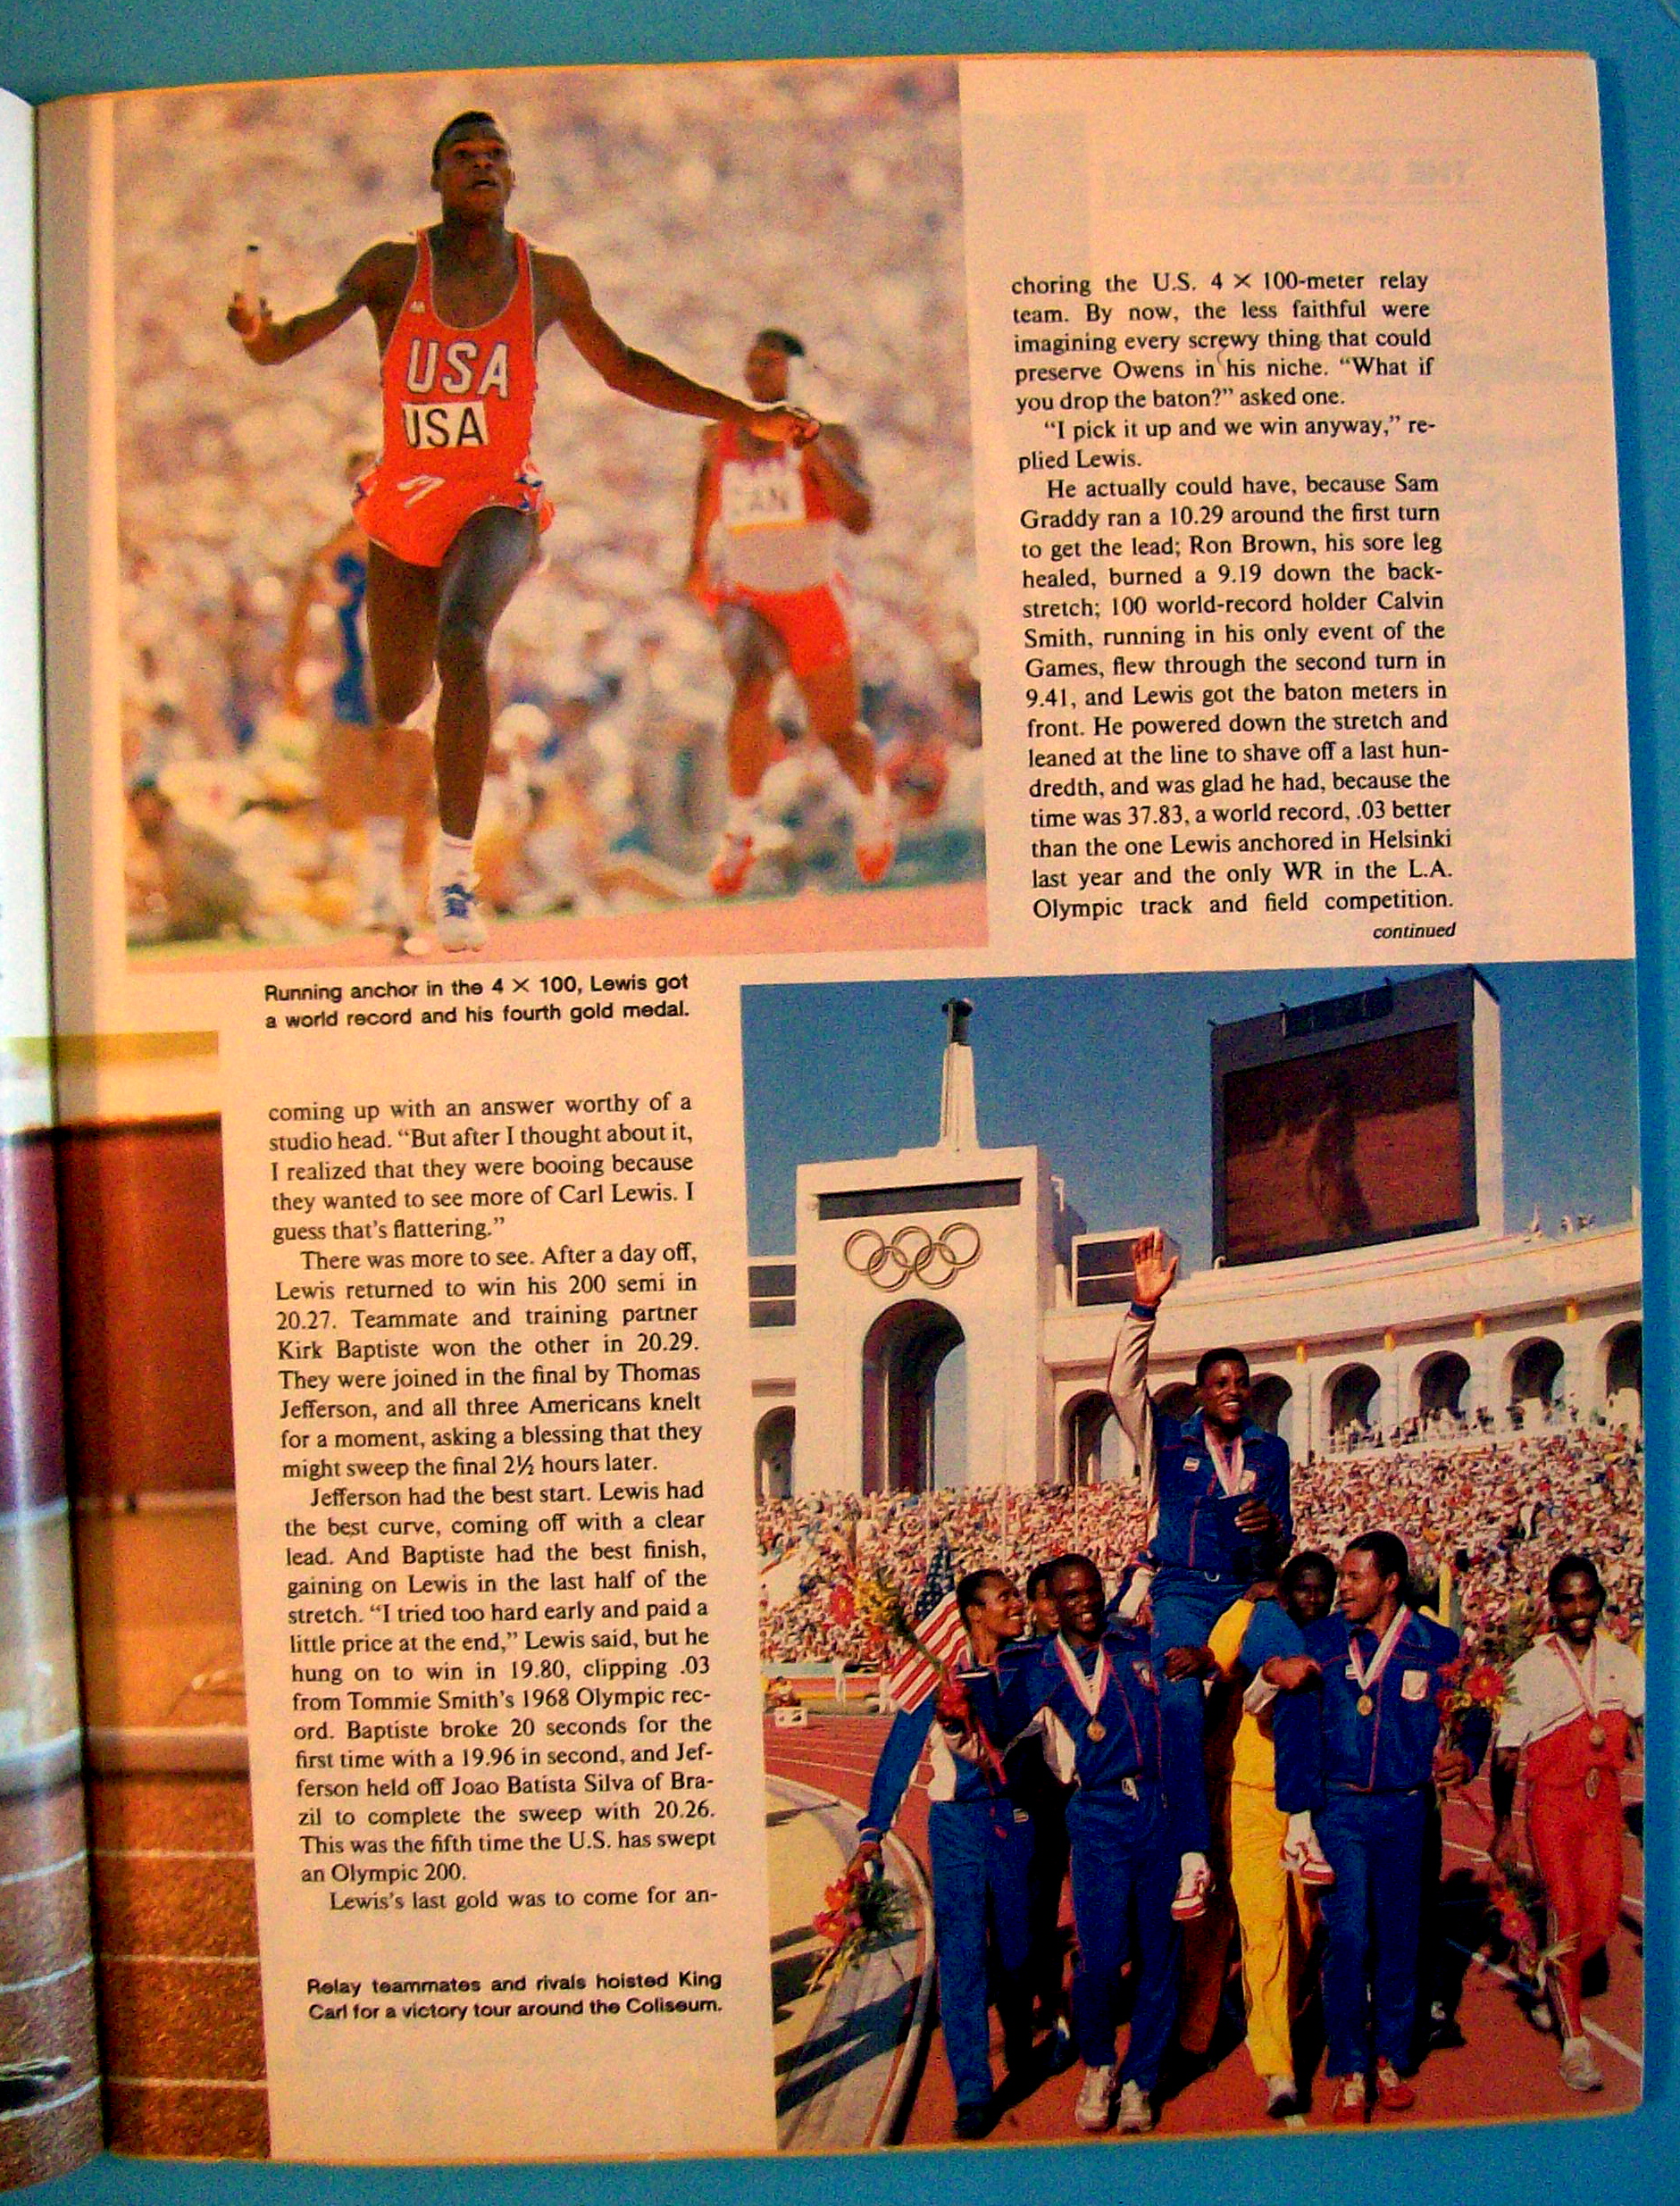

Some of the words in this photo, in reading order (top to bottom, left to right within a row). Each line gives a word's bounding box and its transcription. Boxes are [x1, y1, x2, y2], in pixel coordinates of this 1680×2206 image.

[1012, 308, 1069, 324] team.
[1085, 302, 1113, 326] By
[1128, 305, 1179, 323] now,
[1194, 301, 1227, 321] the
[1241, 299, 1278, 320] less
[1291, 298, 1367, 319] faithful
[1381, 304, 1430, 319] were
[1014, 331, 1117, 356] imagining
[1124, 335, 1181, 354] every
[1188, 333, 1260, 350] screwy
[1267, 328, 1322, 352] thing
[1327, 328, 1368, 347] that
[1375, 327, 1432, 347] could
[405, 338, 509, 399] USA
[403, 406, 484, 447] USA
[1020, 508, 1101, 532] Graddy
[1107, 512, 1141, 527] ran
[1149, 511, 1161, 526] a
[1170, 504, 1224, 526] 10.29
[1231, 504, 1305, 524] around
[1311, 503, 1344, 523] the
[1351, 502, 1391, 522] first
[1397, 506, 1441, 522] turn
[1022, 567, 1097, 590] healed,
[1108, 564, 1183, 587] burned
[1194, 569, 1207, 585] a
[1217, 563, 1262, 584] 9.19
[1273, 563, 1332, 582] down
[1343, 561, 1375, 581] the
[1387, 561, 1443, 581] back-
[1024, 627, 1094, 649] Smith,
[1103, 624, 1186, 649] running
[1195, 623, 1216, 644] in
[1224, 623, 1255, 643] his
[1263, 622, 1309, 646] only
[1317, 624, 1375, 641] event
[1383, 620, 1407, 640] of
[1413, 620, 1445, 640] the
[1026, 717, 1085, 739] front.
[1093, 715, 1124, 737] He
[1131, 713, 1222, 740] powered
[1228, 713, 1287, 733] down
[1294, 711, 1327, 731] the
[1331, 709, 1403, 731] stretch
[1410, 708, 1449, 730] and
[1031, 838, 1078, 858] than
[1085, 837, 1118, 857] the
[1124, 840, 1163, 856] one
[1170, 833, 1232, 855] Lewis
[1237, 831, 1334, 853] anchored
[1341, 830, 1361, 850] in
[1367, 828, 1452, 850] Helsinki
[1032, 897, 1124, 923] Olympic
[1140, 894, 1193, 915] track
[1209, 892, 1249, 914] and
[1264, 890, 1308, 913] field
[1325, 888, 1454, 914] competition.
[1372, 921, 1458, 940] continued
[264, 983, 343, 1005] Running
[350, 981, 419, 999] anchor
[426, 980, 444, 997] in
[450, 978, 484, 997] the
[490, 977, 505, 995] 4
[539, 975, 583, 996] 100,
[589, 973, 648, 992] Lewis
[655, 973, 689, 995] got
[265, 1015, 278, 1030] a
[284, 1009, 339, 1029] world
[347, 1007, 413, 1027] record
[421, 1006, 458, 1024] and
[465, 1005, 494, 1024] his
[502, 1003, 562, 1023] fourth
[569, 1001, 614, 1024] gold
[623, 999, 690, 1019] medal.
[268, 1101, 346, 1124] coming
[354, 1104, 380, 1124] up
[389, 1098, 436, 1118] with
[446, 1102, 471, 1117] an
[481, 1099, 556, 1116] answer
[564, 1092, 640, 1116] worthy
[648, 1090, 673, 1112] of
[680, 1096, 692, 1111] a
[271, 1161, 279, 1182] I
[287, 1159, 367, 1182] realized
[373, 1159, 414, 1179] that
[422, 1157, 467, 1182] they
[473, 1161, 525, 1176] were
[531, 1154, 605, 1178] booing
[611, 1153, 694, 1174] because
[275, 1280, 336, 1301] Lewis
[346, 1278, 434, 1299] returned
[445, 1281, 466, 1298] to
[477, 1276, 516, 1297] win
[527, 1274, 558, 1296] his
[568, 1274, 607, 1295] 200
[617, 1272, 665, 1293] semi
[677, 1272, 698, 1291] in
[276, 1309, 337, 1331] 20.27.
[350, 1308, 458, 1329] Teammate
[472, 1306, 512, 1327] and
[525, 1304, 608, 1328] training
[622, 1306, 699, 1327] partner
[277, 1340, 323, 1360] Kirk
[336, 1339, 419, 1363] Baptiste
[431, 1341, 476, 1358] won
[489, 1336, 522, 1357] the
[534, 1334, 590, 1355] other
[603, 1333, 623, 1353] in
[637, 1331, 699, 1352] 20.29.
[286, 1546, 334, 1567] lead.
[346, 1545, 390, 1566] And
[401, 1544, 485, 1568] Baptiste
[496, 1542, 535, 1563] had
[546, 1542, 579, 1562] the
[590, 1541, 632, 1561] best
[643, 1538, 707, 1561] finish,
[290, 1663, 344, 1686] hung
[354, 1667, 380, 1682] on
[392, 1665, 414, 1682] to
[425, 1661, 464, 1681] win
[476, 1660, 496, 1681] in
[512, 1659, 572, 1681] 19.80,
[582, 1657, 668, 1681] clipping
[680, 1655, 710, 1675] .03
[297, 1807, 322, 1826] zil
[334, 1809, 356, 1826] to
[367, 1806, 461, 1829] complete
[473, 1804, 506, 1824] the
[518, 1807, 582, 1826] sweep
[594, 1801, 640, 1821] with
[654, 1799, 715, 1819] 20.26.
[301, 1868, 325, 1883] an
[330, 1862, 419, 1886] Olympic
[424, 1861, 466, 1882] 200.
[306, 1977, 362, 1999] Relay
[371, 1976, 481, 1994] teammates
[490, 1975, 527, 1993] and
[535, 1973, 587, 1992] rivals
[595, 1970, 670, 1990] hoisted
[678, 1969, 723, 1991] King
[308, 2002, 348, 2021] Carl
[352, 2002, 380, 2020] for
[385, 2006, 397, 2019] a
[401, 2001, 469, 2022] victory
[472, 2002, 513, 2018] tour
[516, 1999, 584, 2018] around
[589, 1998, 622, 2016] the
[625, 1996, 723, 2015] Coliseum.
